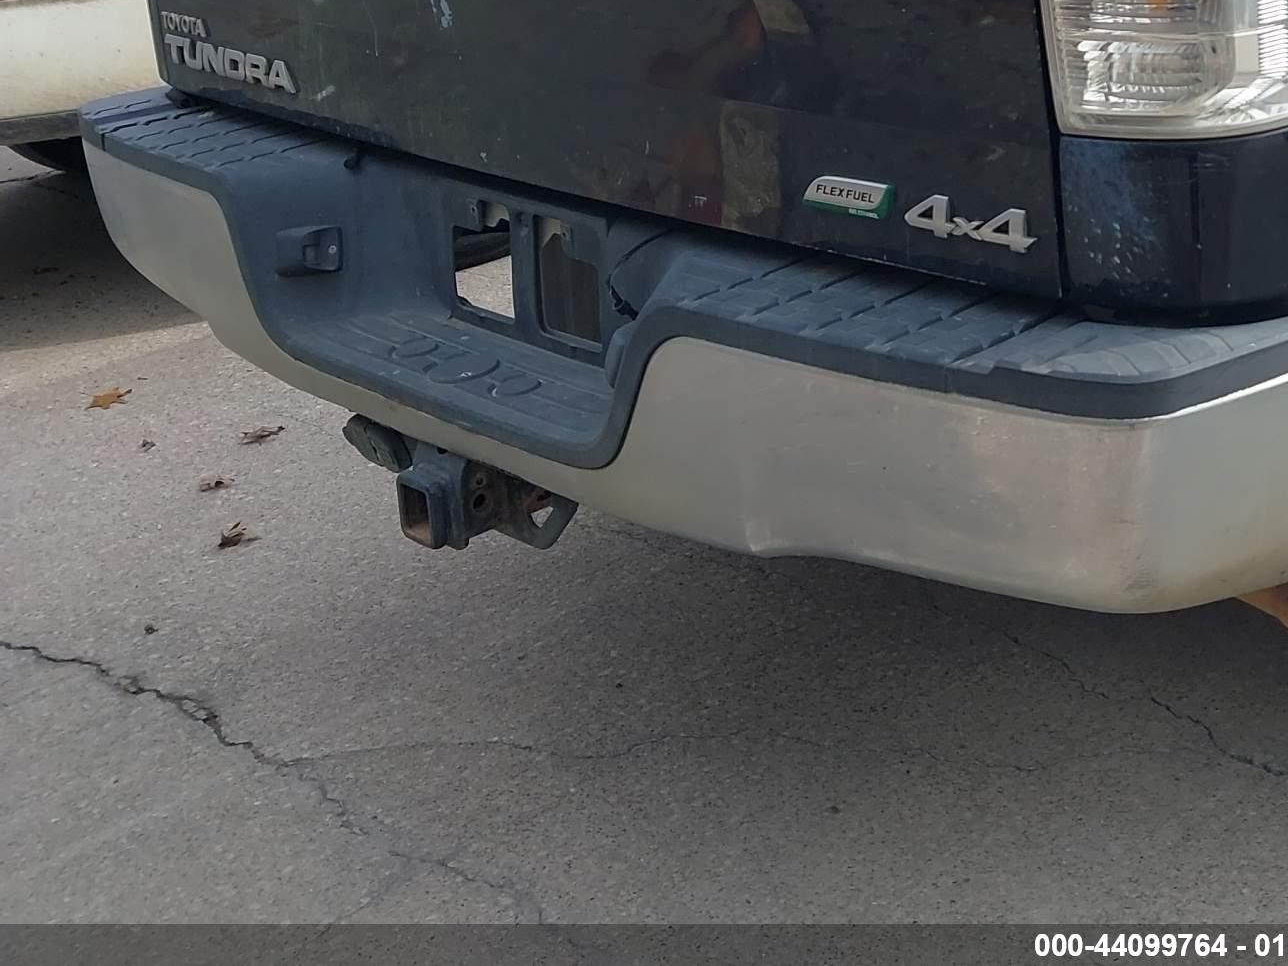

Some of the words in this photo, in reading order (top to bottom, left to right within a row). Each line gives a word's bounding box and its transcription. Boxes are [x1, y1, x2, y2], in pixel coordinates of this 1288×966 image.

[160, 11, 207, 38] TOYOTA
[164, 33, 297, 94] TUNDRA
[815, 183, 845, 199] FLEX
[846, 188, 875, 204] FUEL
[904, 193, 1038, 254] 4x4
